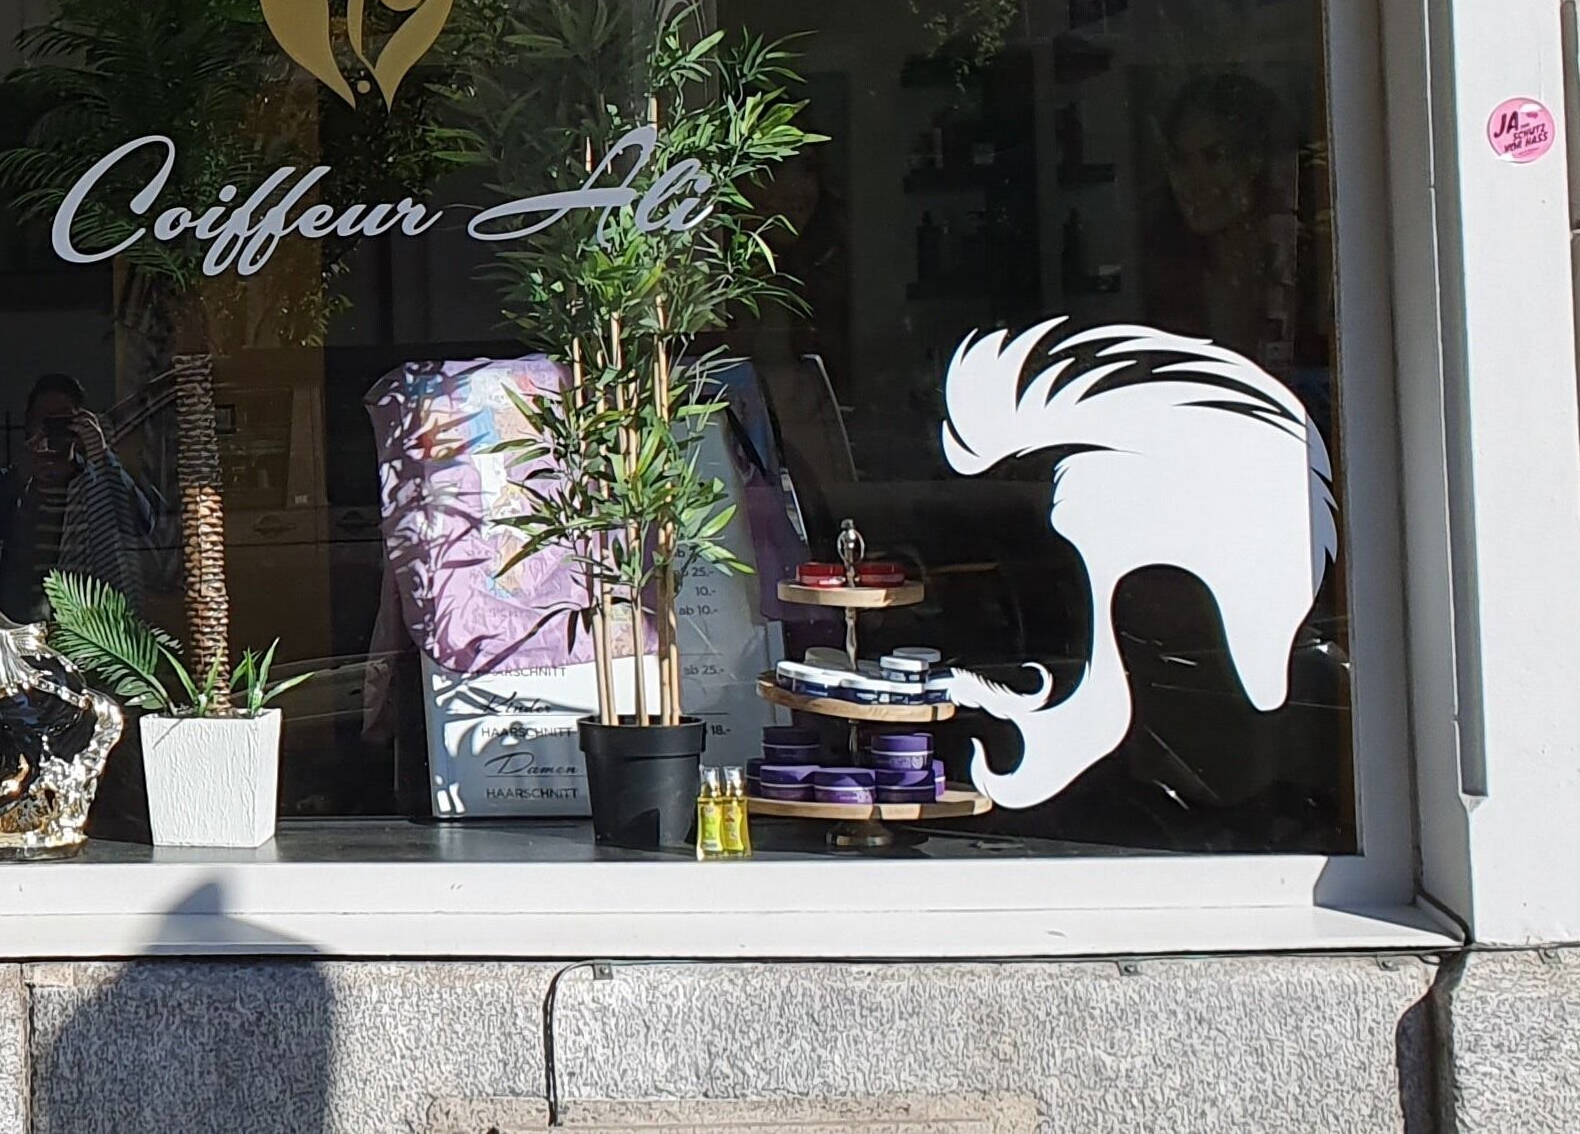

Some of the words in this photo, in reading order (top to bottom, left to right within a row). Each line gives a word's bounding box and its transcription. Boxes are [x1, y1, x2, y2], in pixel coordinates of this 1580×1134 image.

[1493, 110, 1519, 138] JA
[51, 134, 442, 277] Coiffeur
[466, 125, 713, 248] Ali
[695, 586, 717, 597] 10.-
[678, 606, 695, 616] ab
[697, 604, 719, 616] 10.-
[484, 751, 577, 775] Damen
[486, 788, 578, 800] HAARSCHNITT
